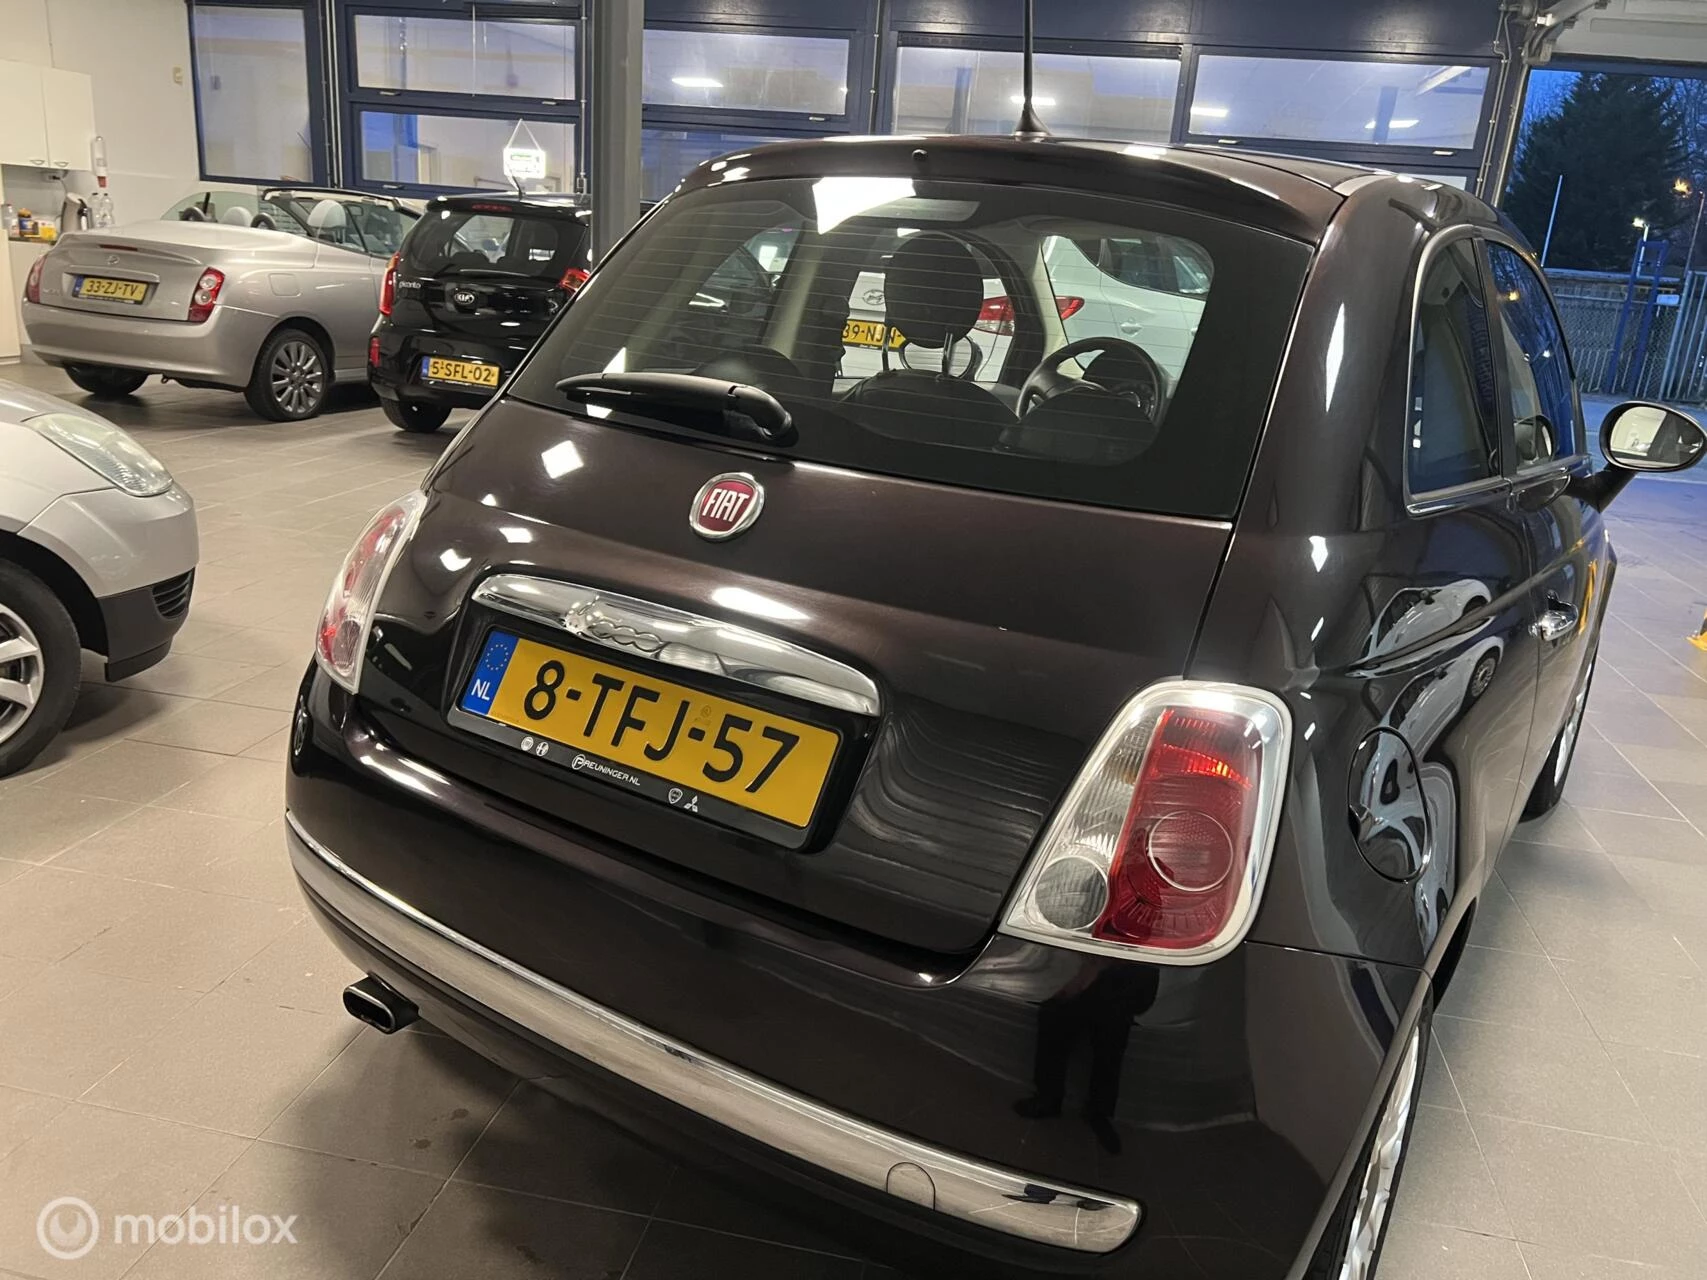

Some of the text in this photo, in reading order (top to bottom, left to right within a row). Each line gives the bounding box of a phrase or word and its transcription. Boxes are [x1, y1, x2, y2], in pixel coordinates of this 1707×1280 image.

[86, 280, 139, 297] 33-ZJ-TV
[431, 361, 492, 382] 5-SFL-02
[702, 488, 750, 522] FIAT
[471, 678, 491, 701] NL
[523, 659, 800, 793] 8-TFJ-57
